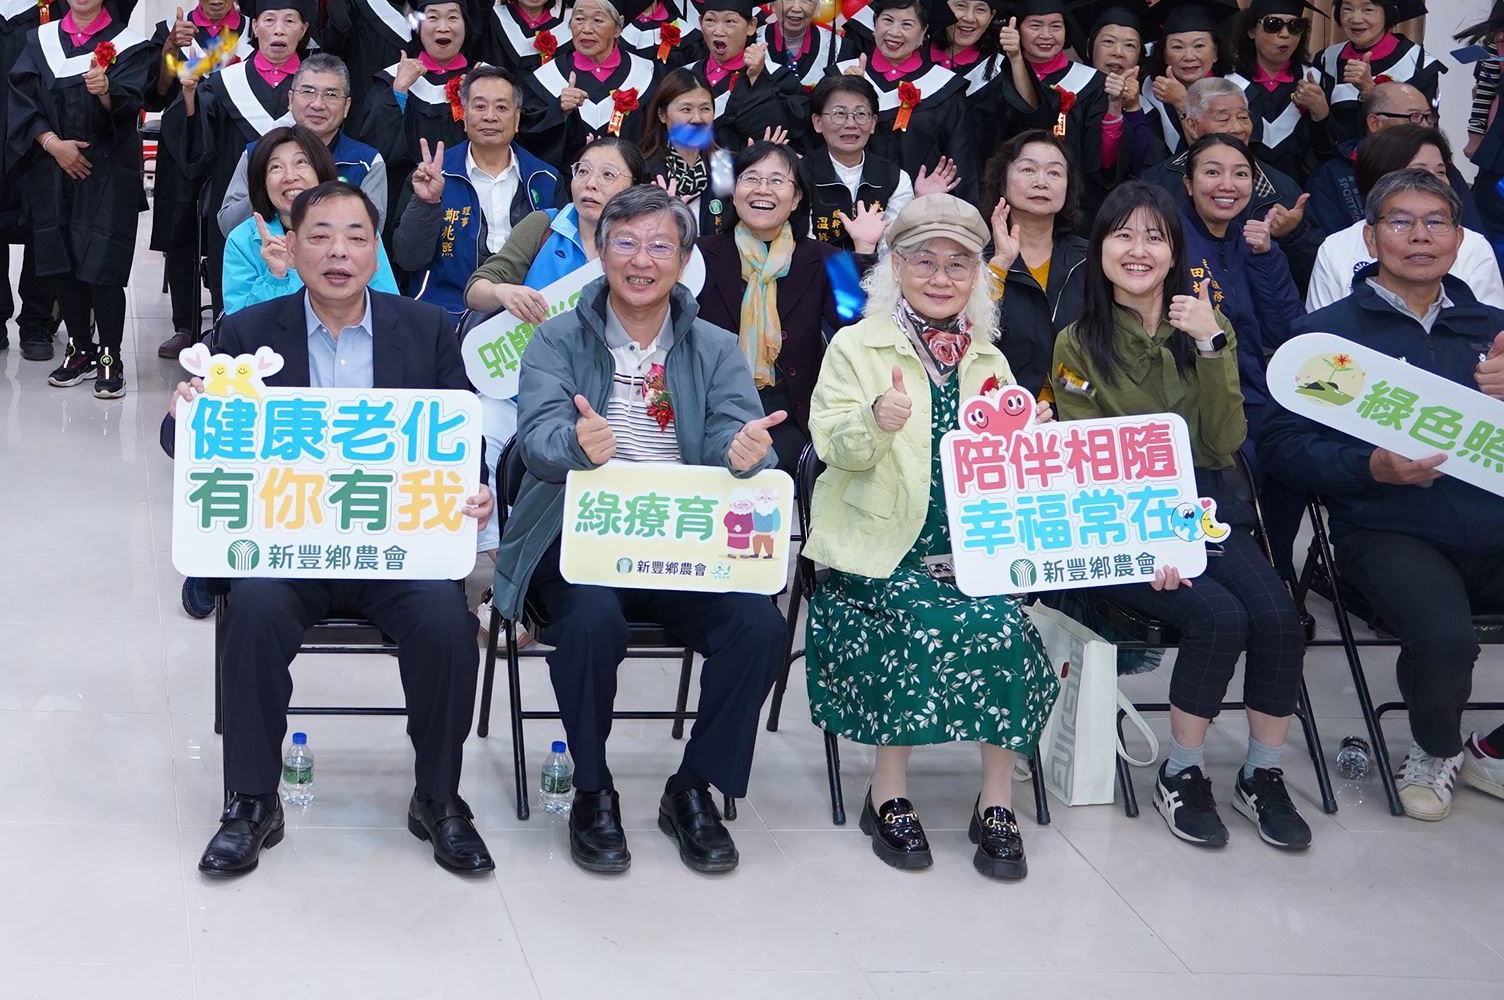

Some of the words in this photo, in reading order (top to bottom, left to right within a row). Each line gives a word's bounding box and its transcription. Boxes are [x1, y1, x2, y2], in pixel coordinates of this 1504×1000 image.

[191, 397, 466, 463] 健康老化
[952, 422, 1178, 494] 陪伴相隨
[189, 467, 465, 531] 有你有我
[574, 490, 719, 541] 綠療育
[960, 485, 1181, 555] 幸福常在
[267, 543, 408, 571] 新豐鄉農會
[636, 559, 708, 577] 新豐鄉農會
[1043, 551, 1156, 584] 新豐鄉農會
